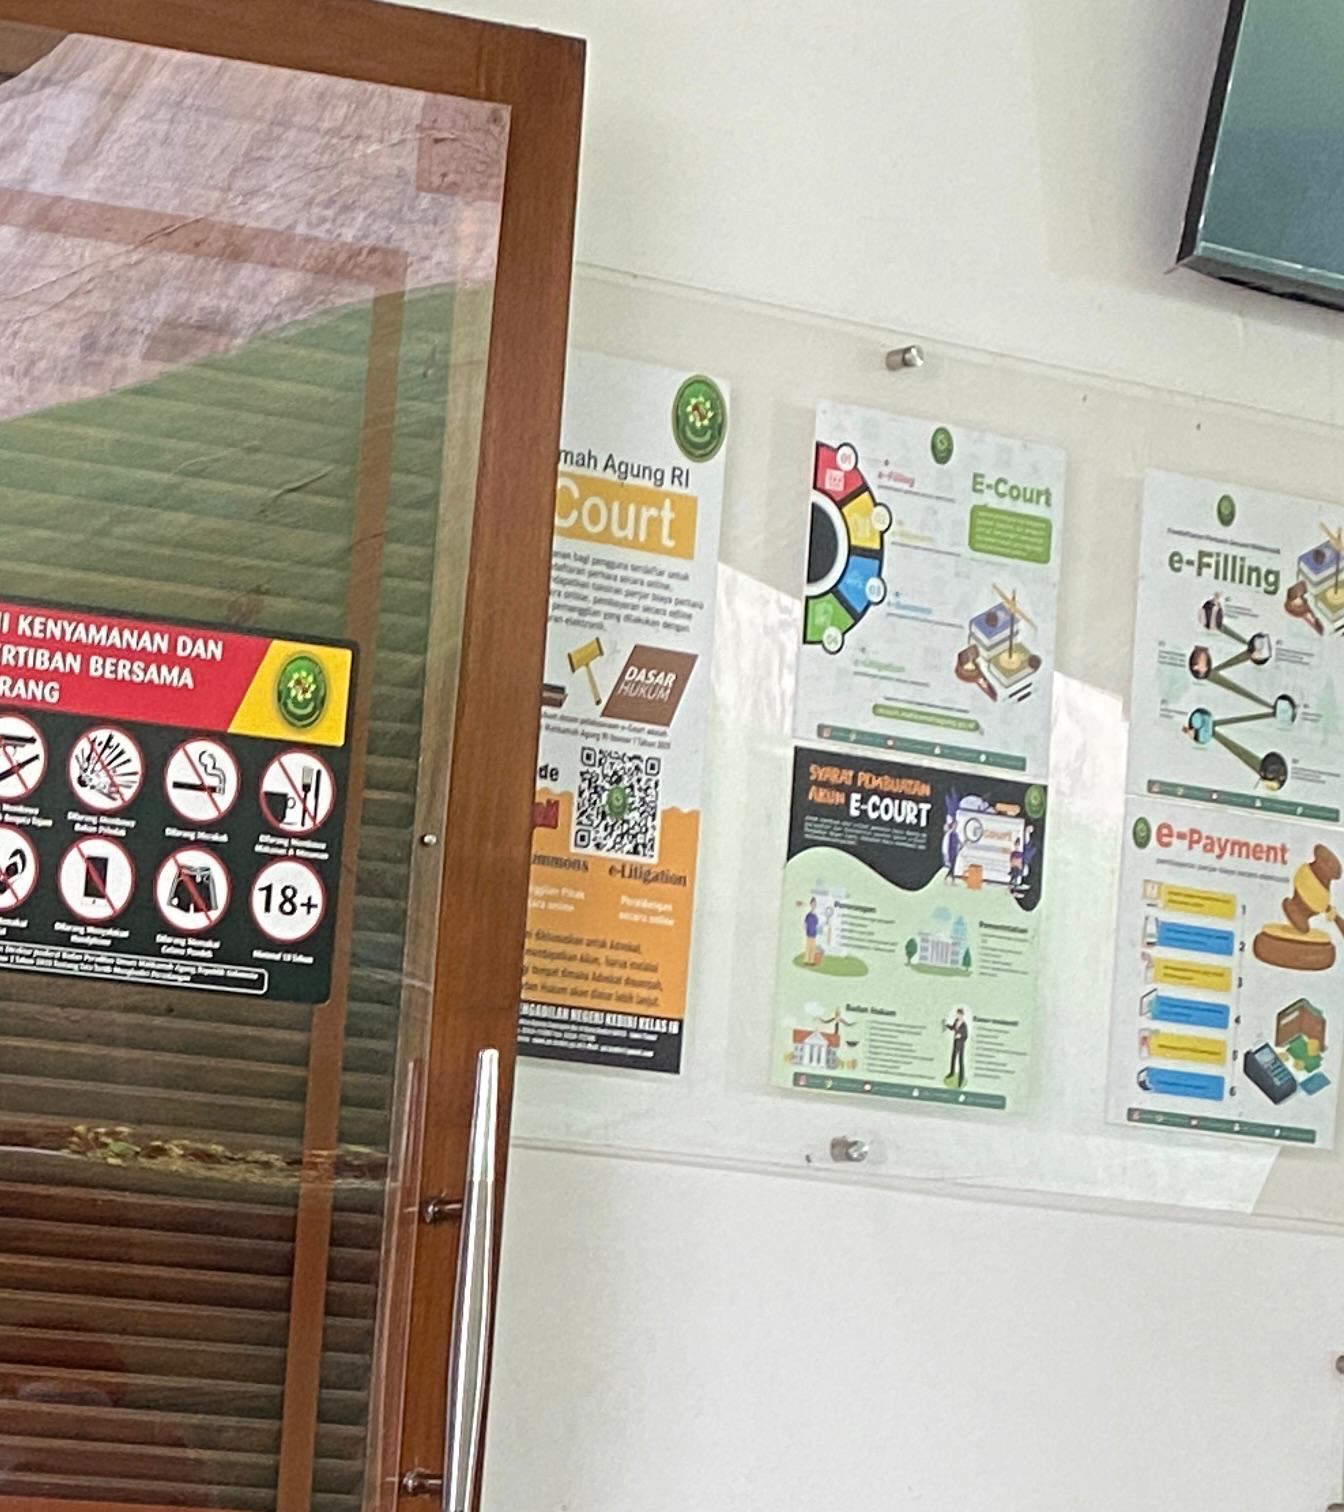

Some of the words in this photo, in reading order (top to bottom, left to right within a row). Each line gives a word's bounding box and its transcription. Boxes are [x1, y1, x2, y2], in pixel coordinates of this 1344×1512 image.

[603, 453, 665, 487] Agung
[670, 466, 690, 488] RI
[972, 472, 1053, 507] E-Court
[555, 477, 676, 548] Court
[1168, 549, 1281, 596] e-Filling
[18, 614, 169, 655] KENYAMANAN
[176, 635, 223, 661] DAN
[89, 656, 194, 689] BERSAMA
[624, 666, 676, 687] DASAR
[618, 679, 671, 702] HUKUM
[809, 764, 854, 786] SYARAT
[857, 771, 931, 797] PEMBUATAN
[808, 786, 846, 805] AKUN
[849, 792, 932, 827] E-COURT
[1156, 821, 1288, 866] e-Payment
[608, 863, 687, 887] e-Litigation
[257, 883, 318, 916] 18+
[1239, 941, 1246, 952] 2
[638, 1017, 667, 1032] KELAS
